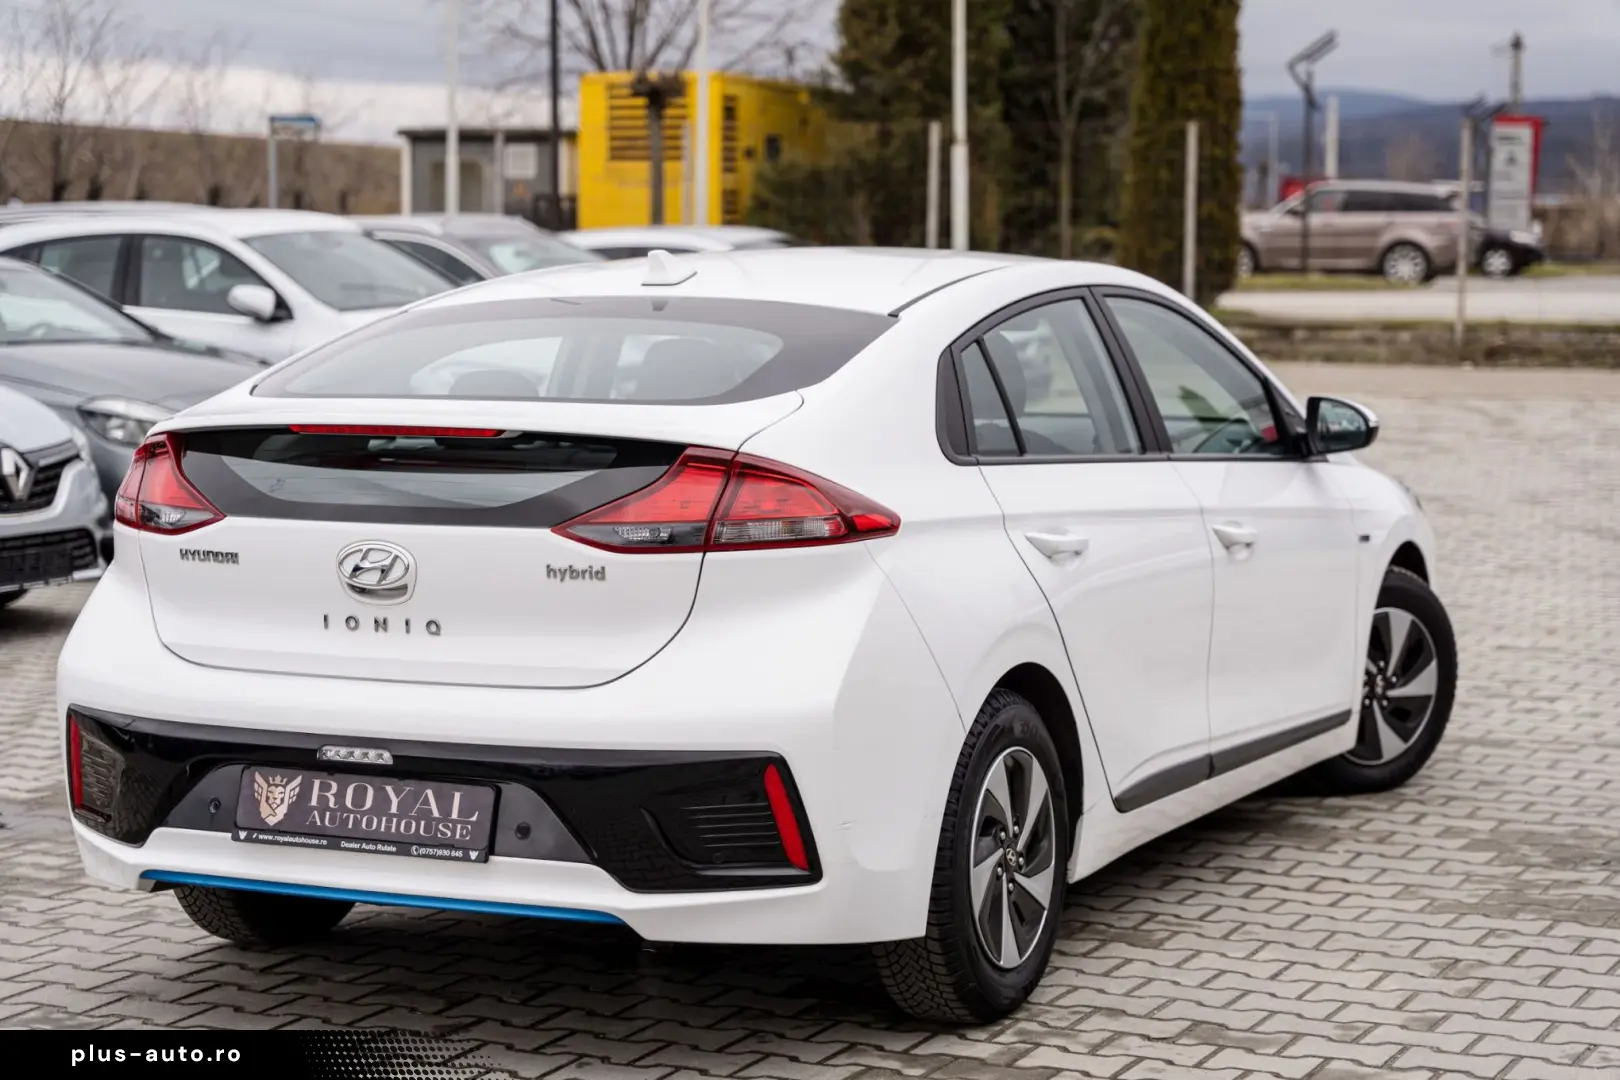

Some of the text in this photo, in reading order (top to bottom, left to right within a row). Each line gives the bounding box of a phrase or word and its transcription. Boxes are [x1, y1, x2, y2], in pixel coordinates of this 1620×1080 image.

[179, 548, 239, 565] HYUNDAI
[546, 564, 606, 582] hybrid
[323, 614, 441, 636] IONIQ
[308, 778, 479, 823] ROYAL
[306, 809, 472, 840] AUTOHOUSE
[258, 833, 328, 846] www.royalautohouse.ro
[340, 841, 361, 849] Dealer
[361, 843, 376, 851] Auto
